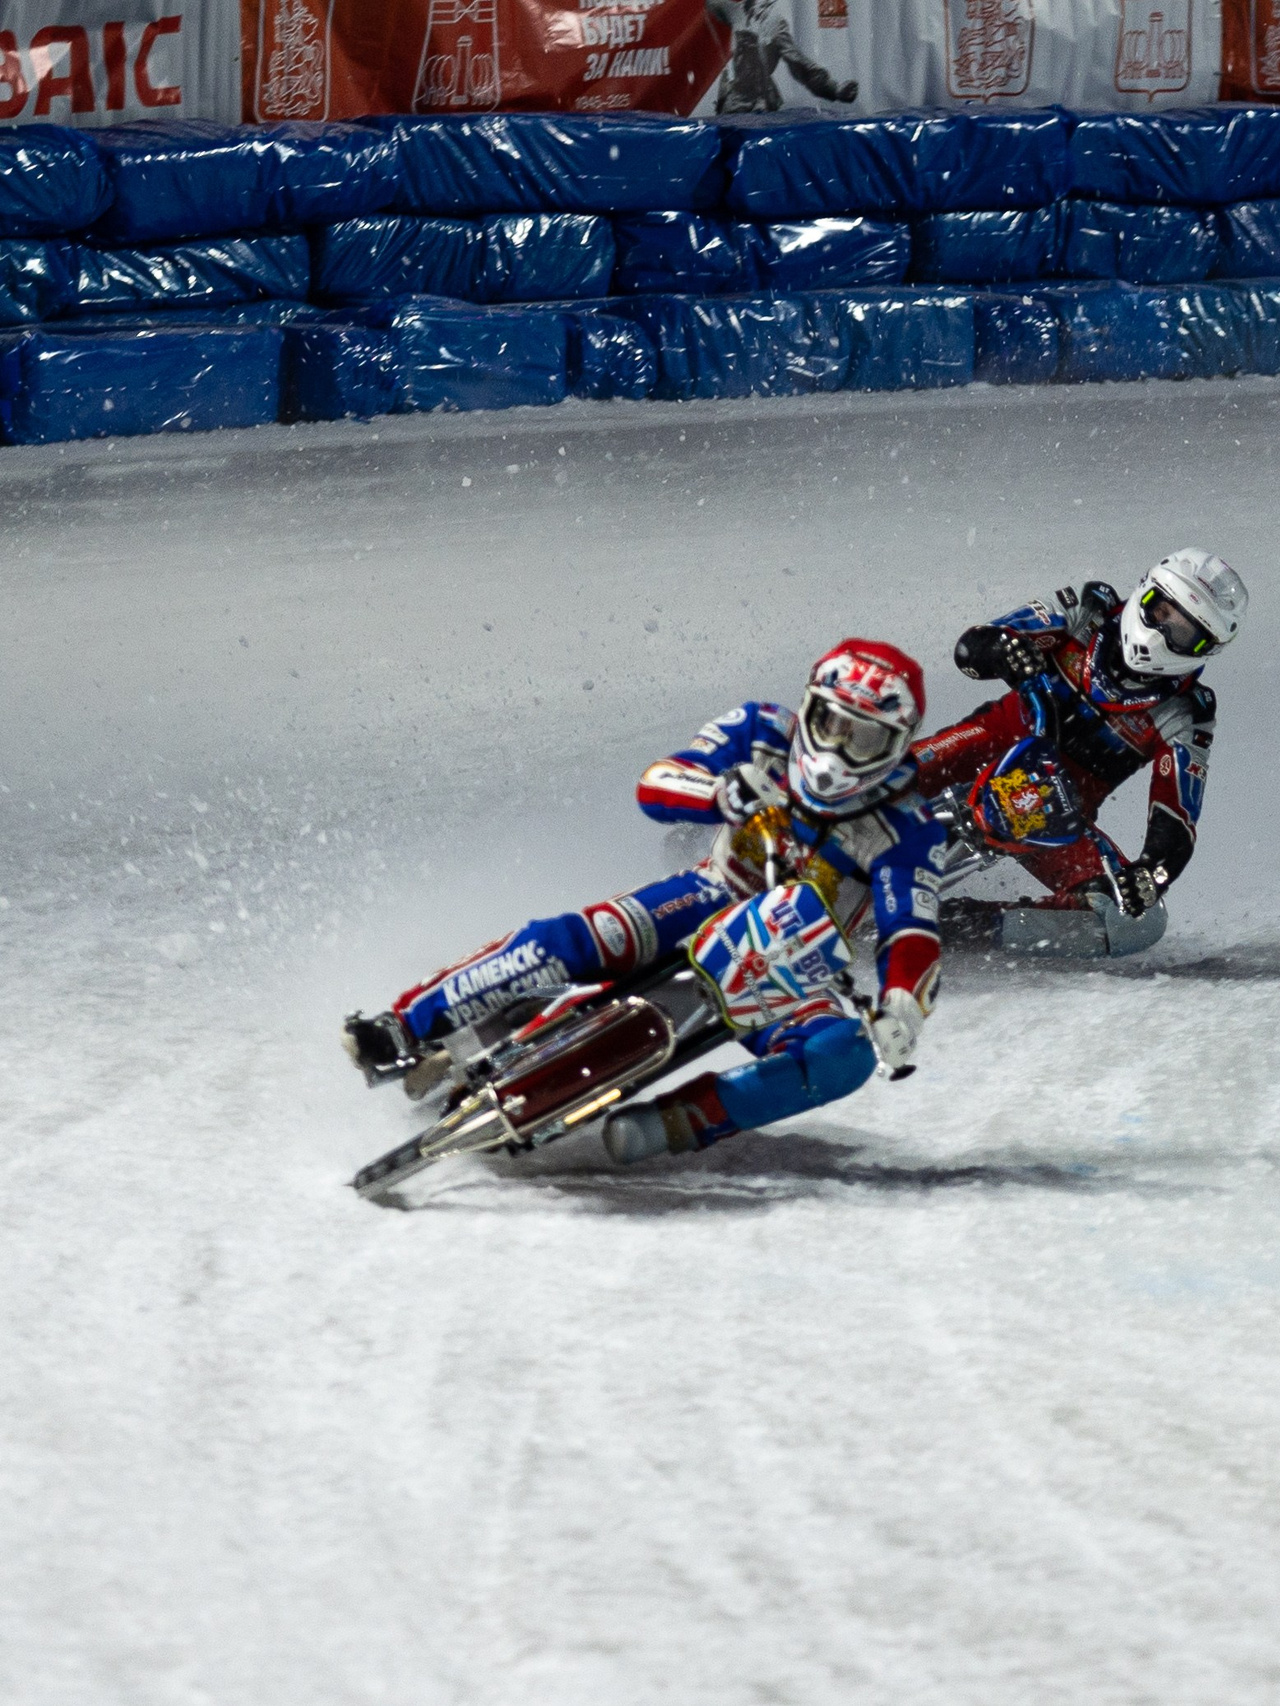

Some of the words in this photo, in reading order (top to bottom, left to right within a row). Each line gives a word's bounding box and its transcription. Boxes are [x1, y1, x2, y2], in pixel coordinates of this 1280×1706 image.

[582, 13, 647, 49] БУДЕТ
[583, 52, 609, 82] ЗА
[607, 46, 671, 78] НАМИ!
